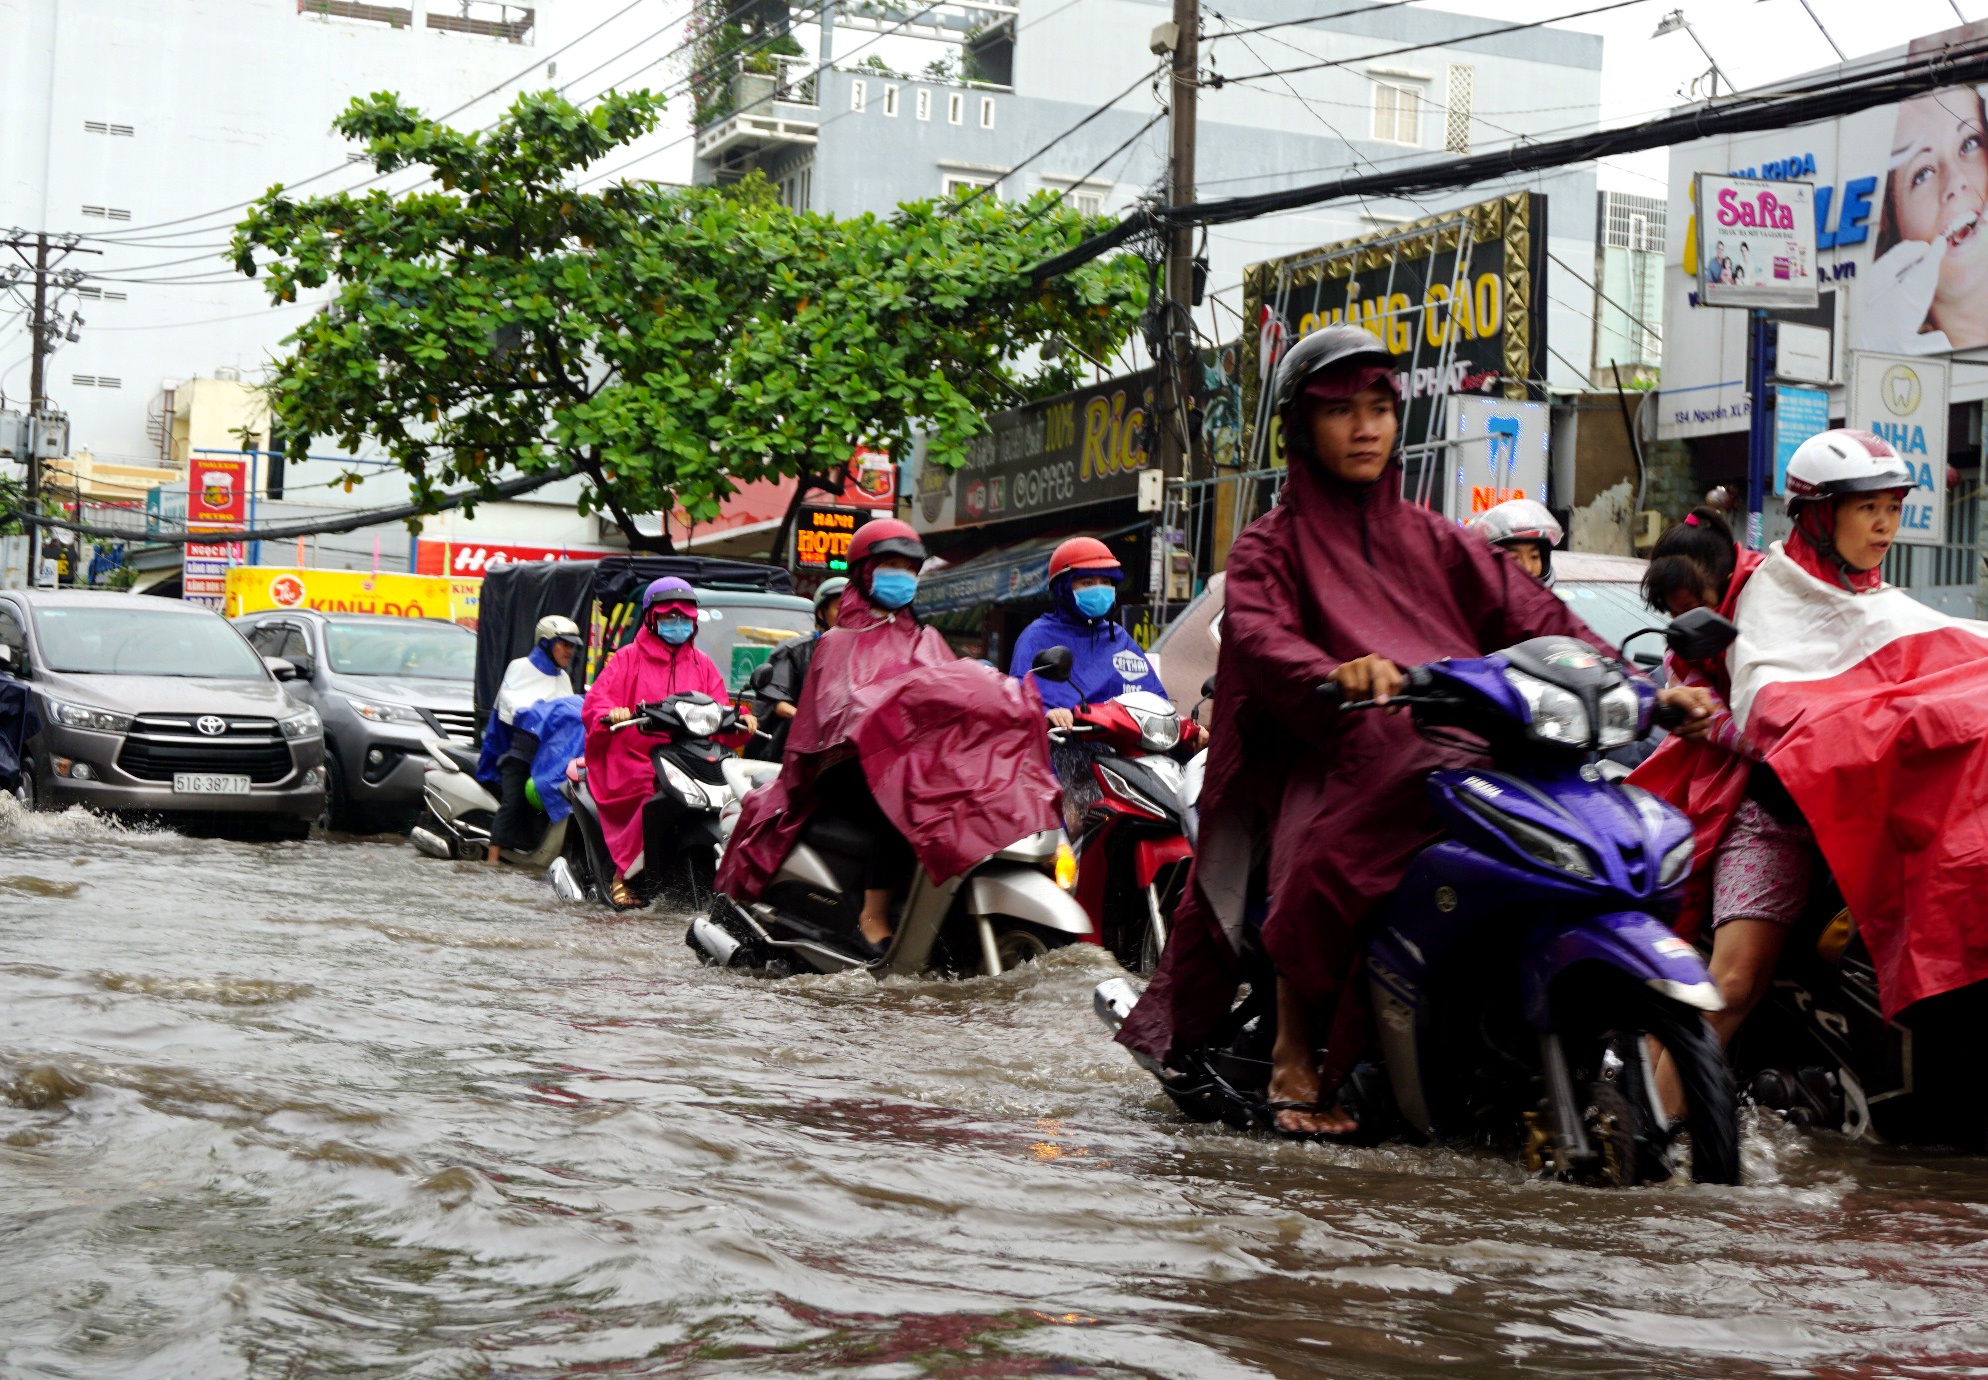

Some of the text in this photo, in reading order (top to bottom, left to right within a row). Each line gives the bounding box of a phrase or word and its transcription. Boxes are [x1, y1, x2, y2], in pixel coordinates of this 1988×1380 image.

[1762, 153, 1816, 180] KHOA
[1717, 188, 1794, 230] SaRa
[1300, 262, 1501, 355] ẢNG CÁO
[1872, 421, 1928, 455] NHA
[1903, 461, 1935, 492] OA
[1471, 486, 1526, 513] NHA
[1899, 505, 1933, 529] ILE
[798, 530, 853, 555] HOTE
[452, 585, 474, 594] KIM
[310, 598, 424, 618] KINH ĐÔ
[176, 776, 248, 791] 51G-387.17
